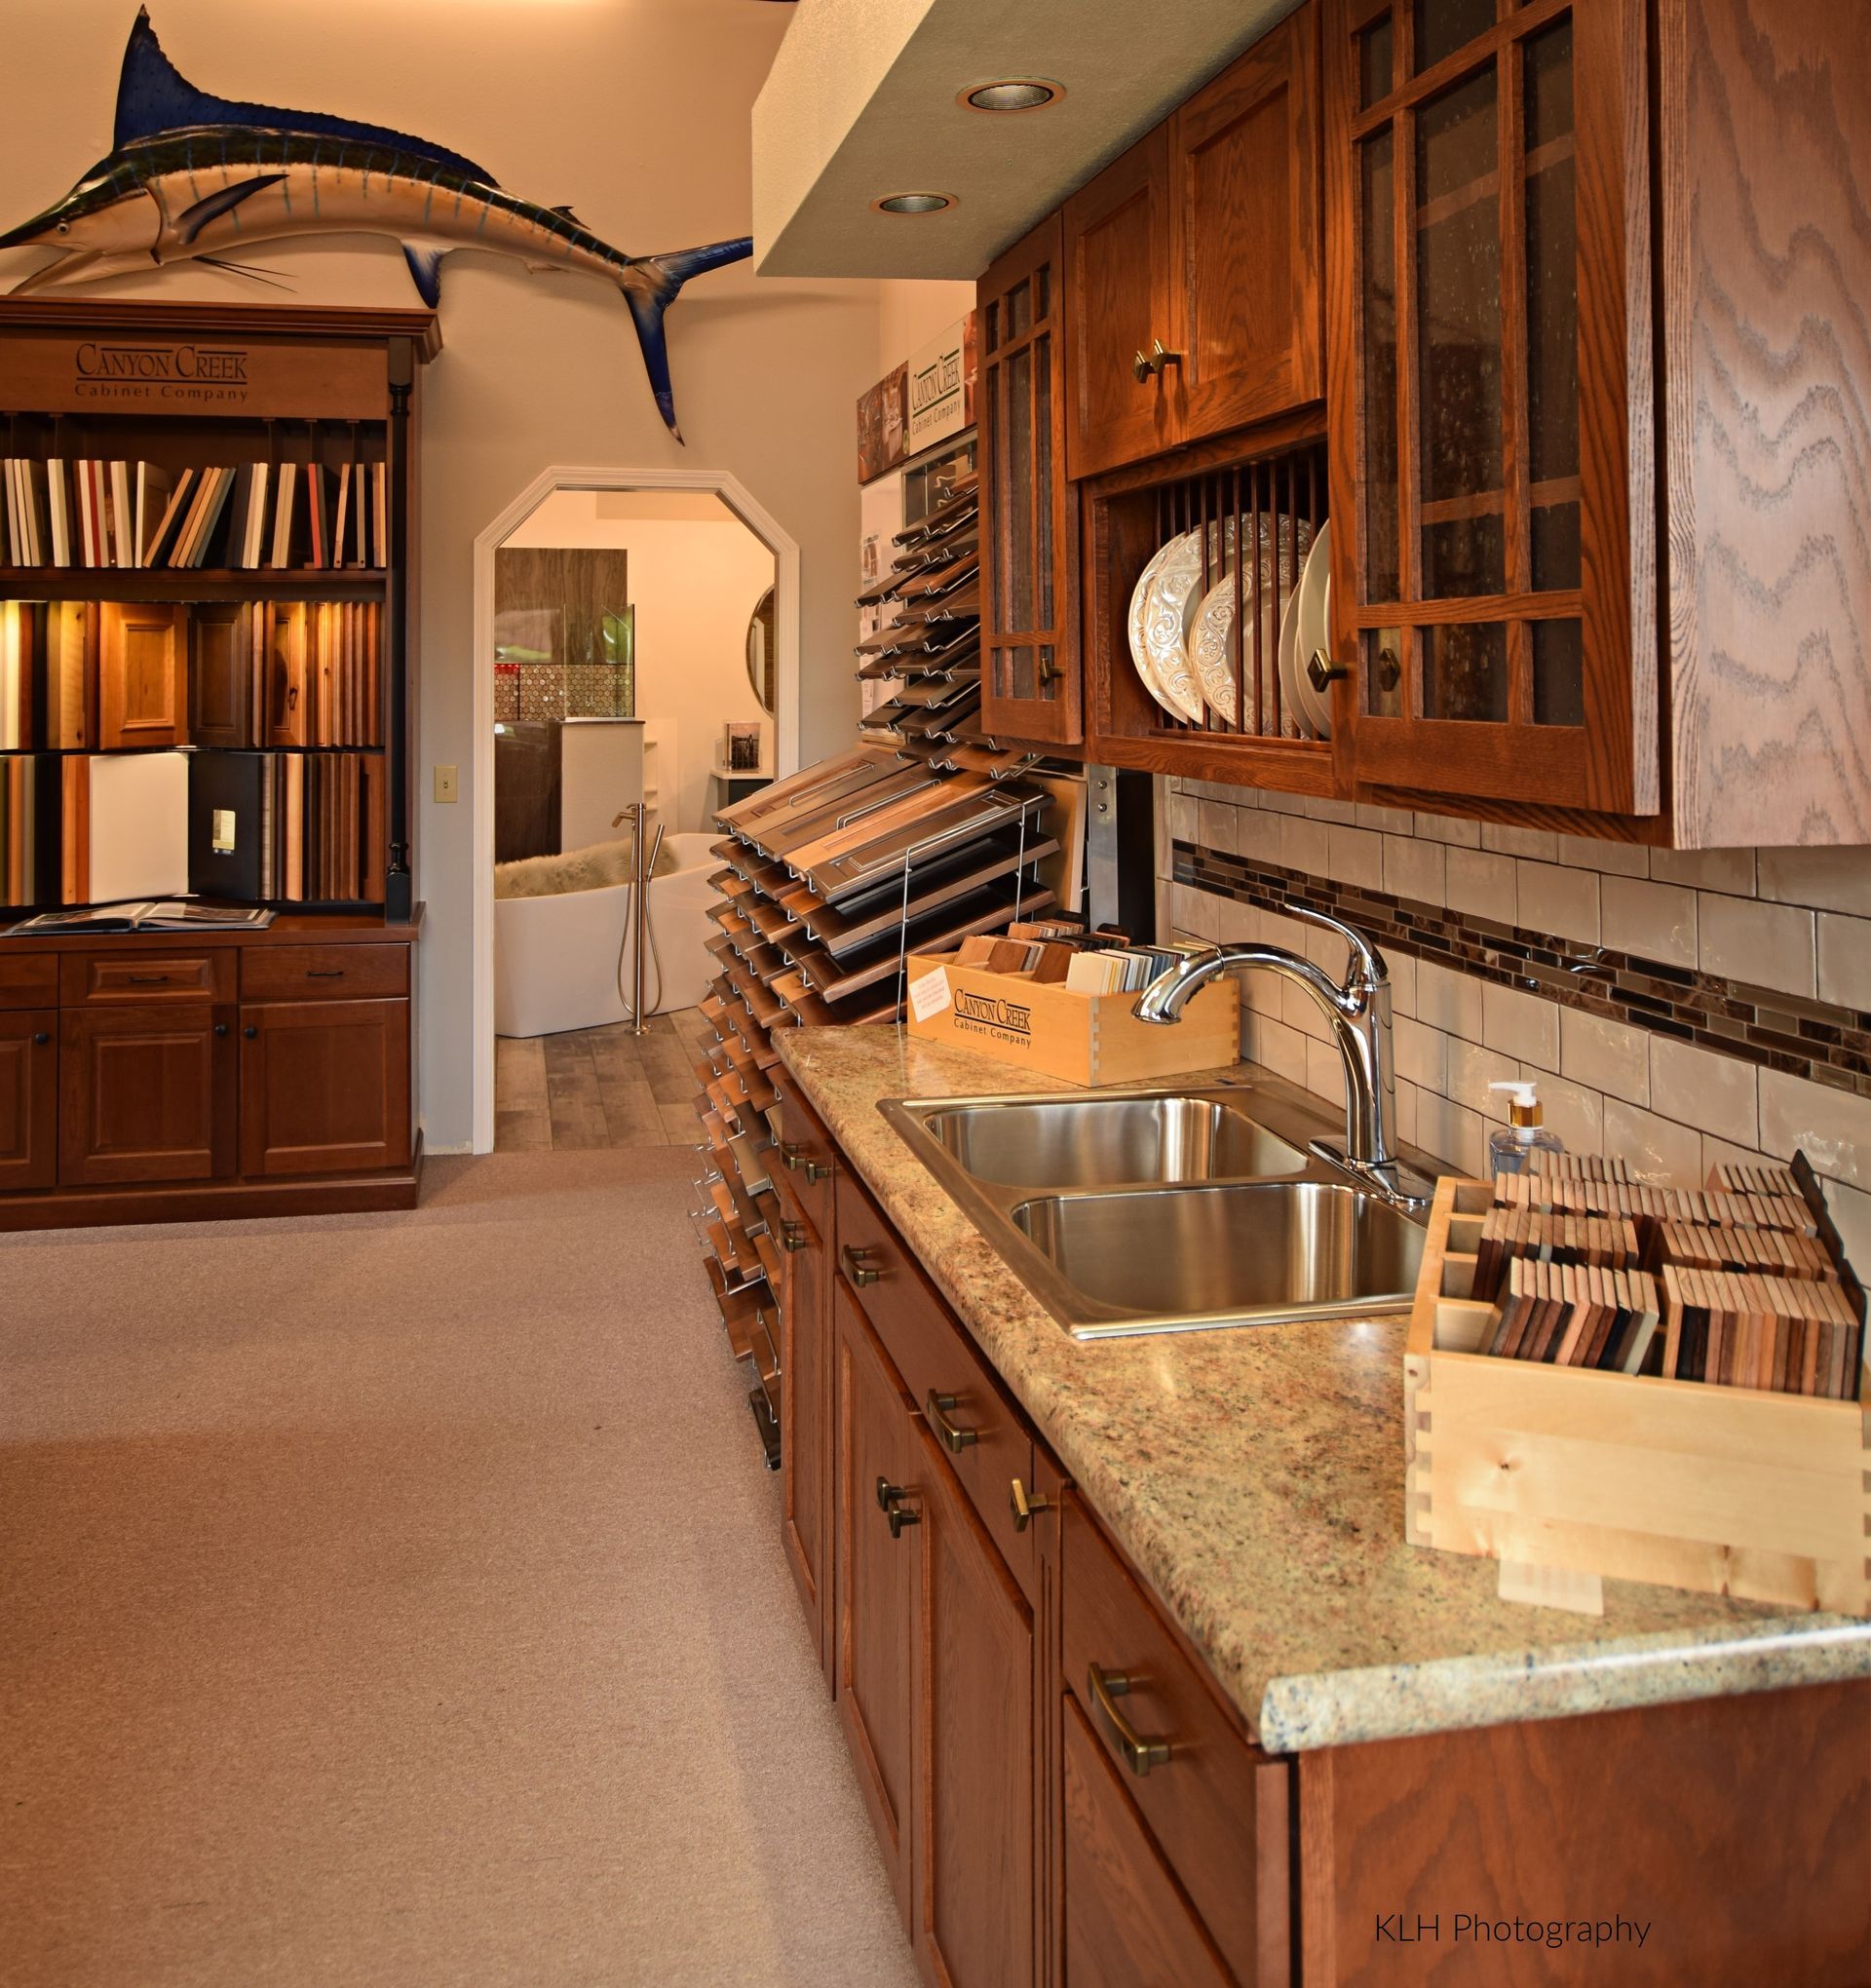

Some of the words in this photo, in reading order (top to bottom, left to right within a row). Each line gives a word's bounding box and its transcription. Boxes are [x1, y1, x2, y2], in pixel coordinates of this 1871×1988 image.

[76, 343, 170, 376] CANYON
[175, 346, 248, 379] CREEK
[75, 383, 150, 398] Cabinet
[161, 385, 248, 402] Company
[912, 371, 937, 410] CANYON
[937, 356, 961, 394] CREEK
[912, 413, 933, 436] Cabinet
[934, 401, 961, 423] Company
[954, 988, 995, 1020] CANYON
[997, 999, 1031, 1030] CREEK
[954, 1018, 986, 1035] Cabinet
[990, 1028, 1032, 1050] Company
